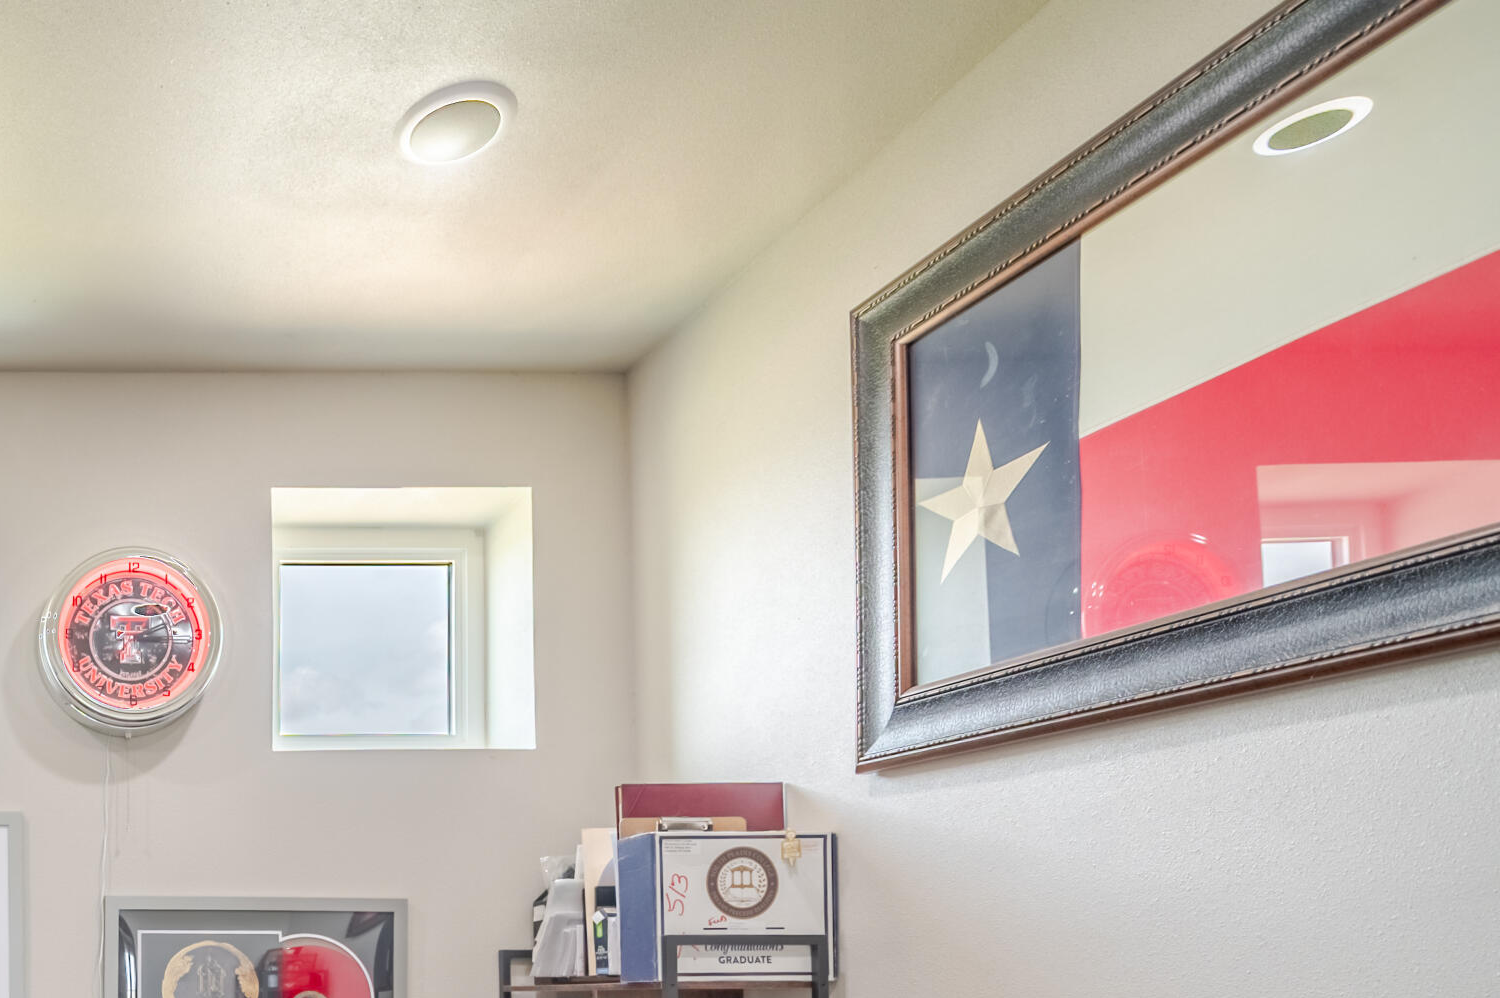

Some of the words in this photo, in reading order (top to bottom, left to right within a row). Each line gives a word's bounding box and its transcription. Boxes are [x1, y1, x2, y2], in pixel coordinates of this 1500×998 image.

[128, 562, 140, 572] 12
[74, 580, 134, 625] TEXAS
[139, 582, 187, 625] TECH
[78, 654, 183, 698] UNIVERSITY
[718, 955, 773, 965] GRADUATE
